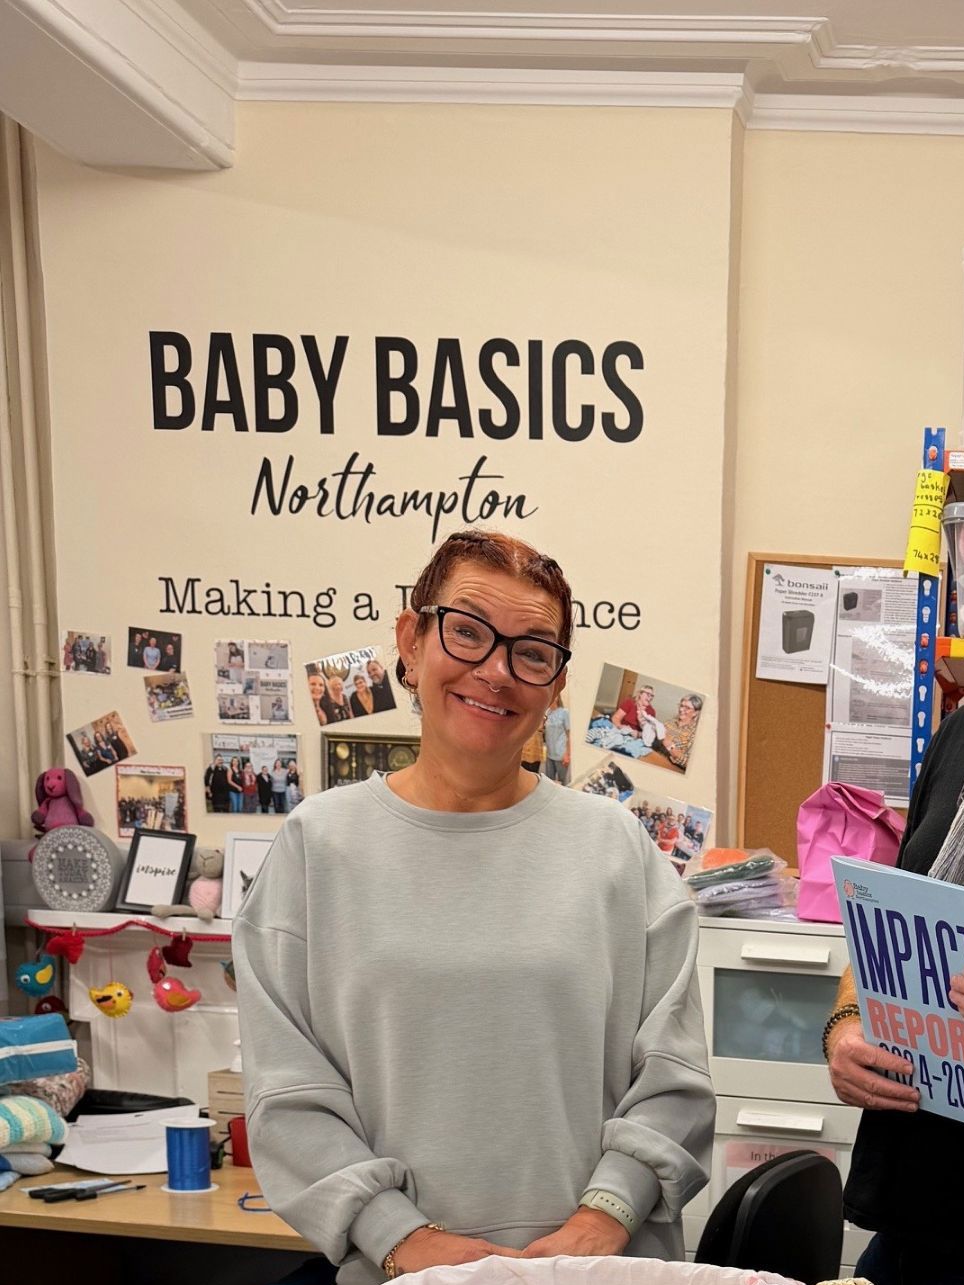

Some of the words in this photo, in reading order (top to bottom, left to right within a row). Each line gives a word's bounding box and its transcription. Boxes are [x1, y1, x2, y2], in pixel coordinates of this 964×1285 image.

[149, 331, 349, 435] BABY
[374, 336, 645, 444] BASICS
[251, 451, 539, 544] Northampton
[159, 575, 338, 628] Making
[352, 589, 379, 622] a
[750, 1151, 761, 1161] In
